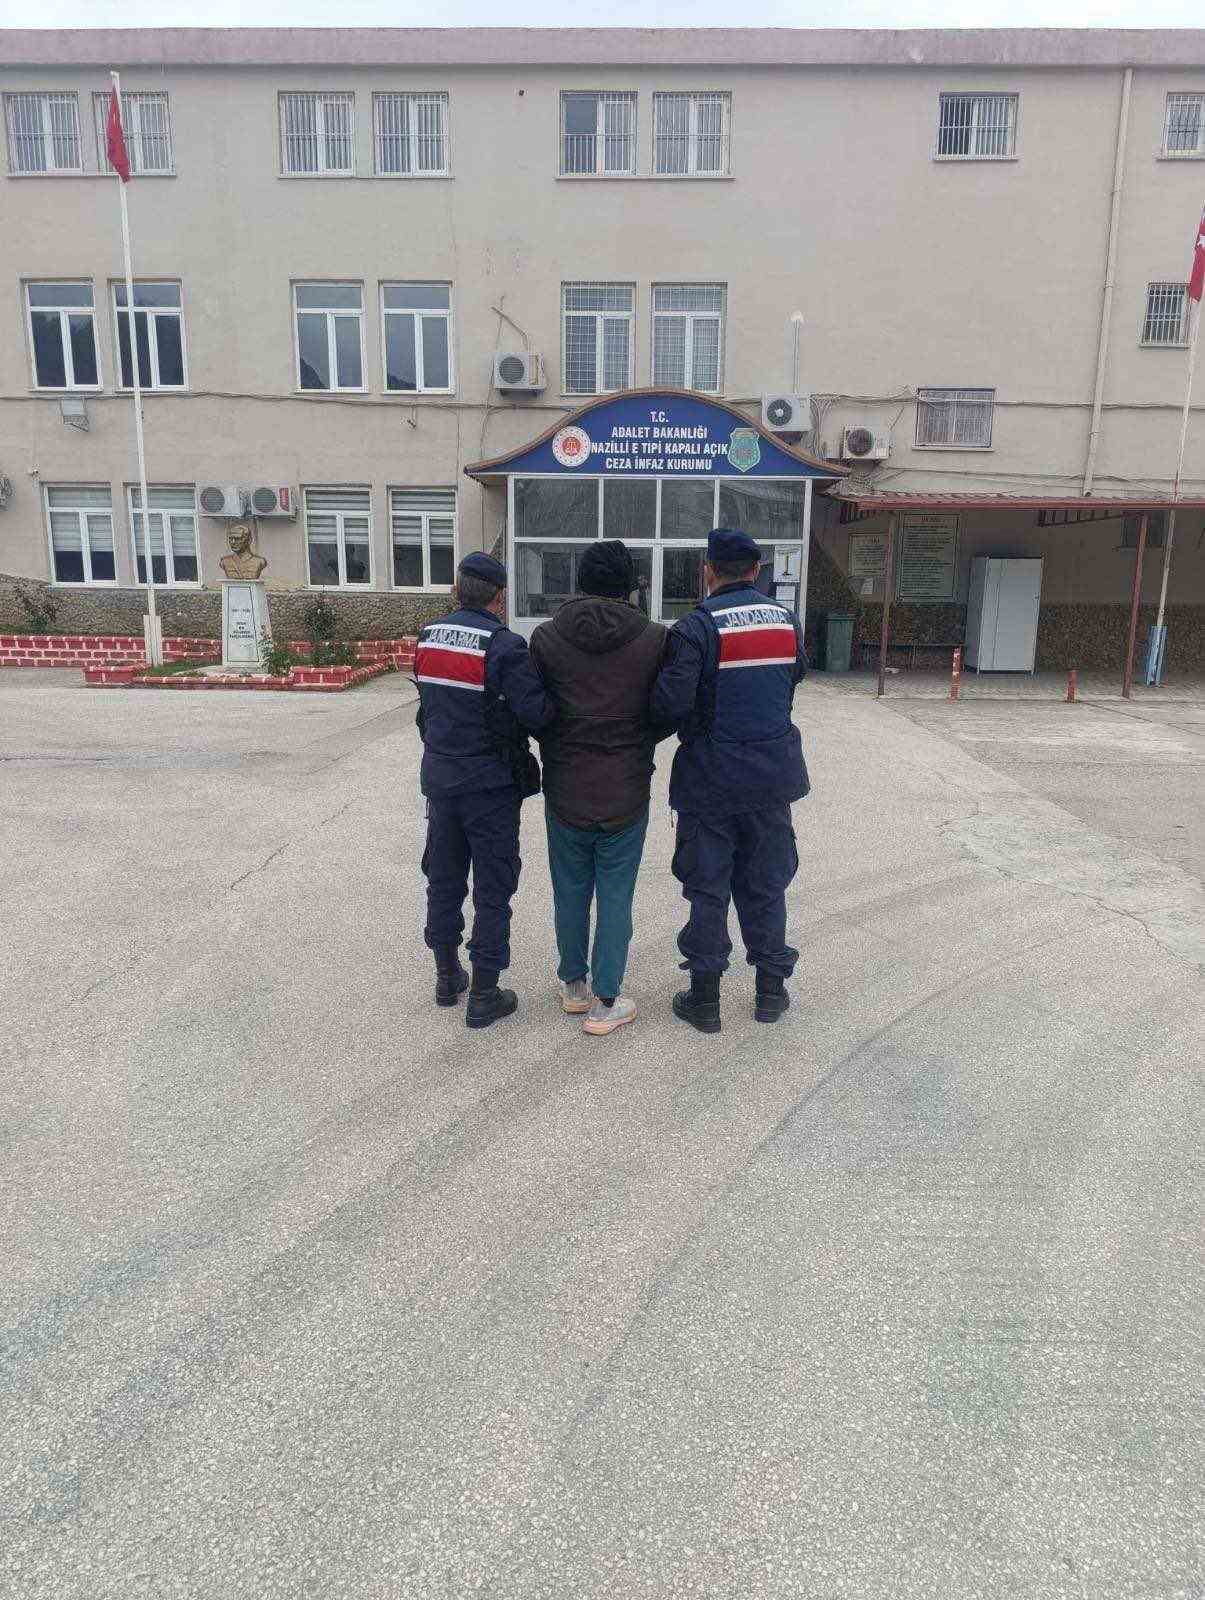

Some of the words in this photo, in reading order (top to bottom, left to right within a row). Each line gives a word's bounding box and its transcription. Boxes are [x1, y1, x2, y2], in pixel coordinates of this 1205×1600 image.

[650, 411, 668, 422] T.C.
[611, 427, 650, 438] ADALET
[653, 425, 707, 438] BAKANLIĞI
[632, 443, 639, 453] E
[665, 443, 700, 454] KAPALI
[703, 443, 728, 457] AÇIK
[606, 457, 631, 469] CEZA
[635, 456, 663, 469] İNFAZ
[667, 458, 712, 470] KURUMU
[726, 609, 786, 626] JANDARMA
[426, 628, 479, 650] JANDARMA
